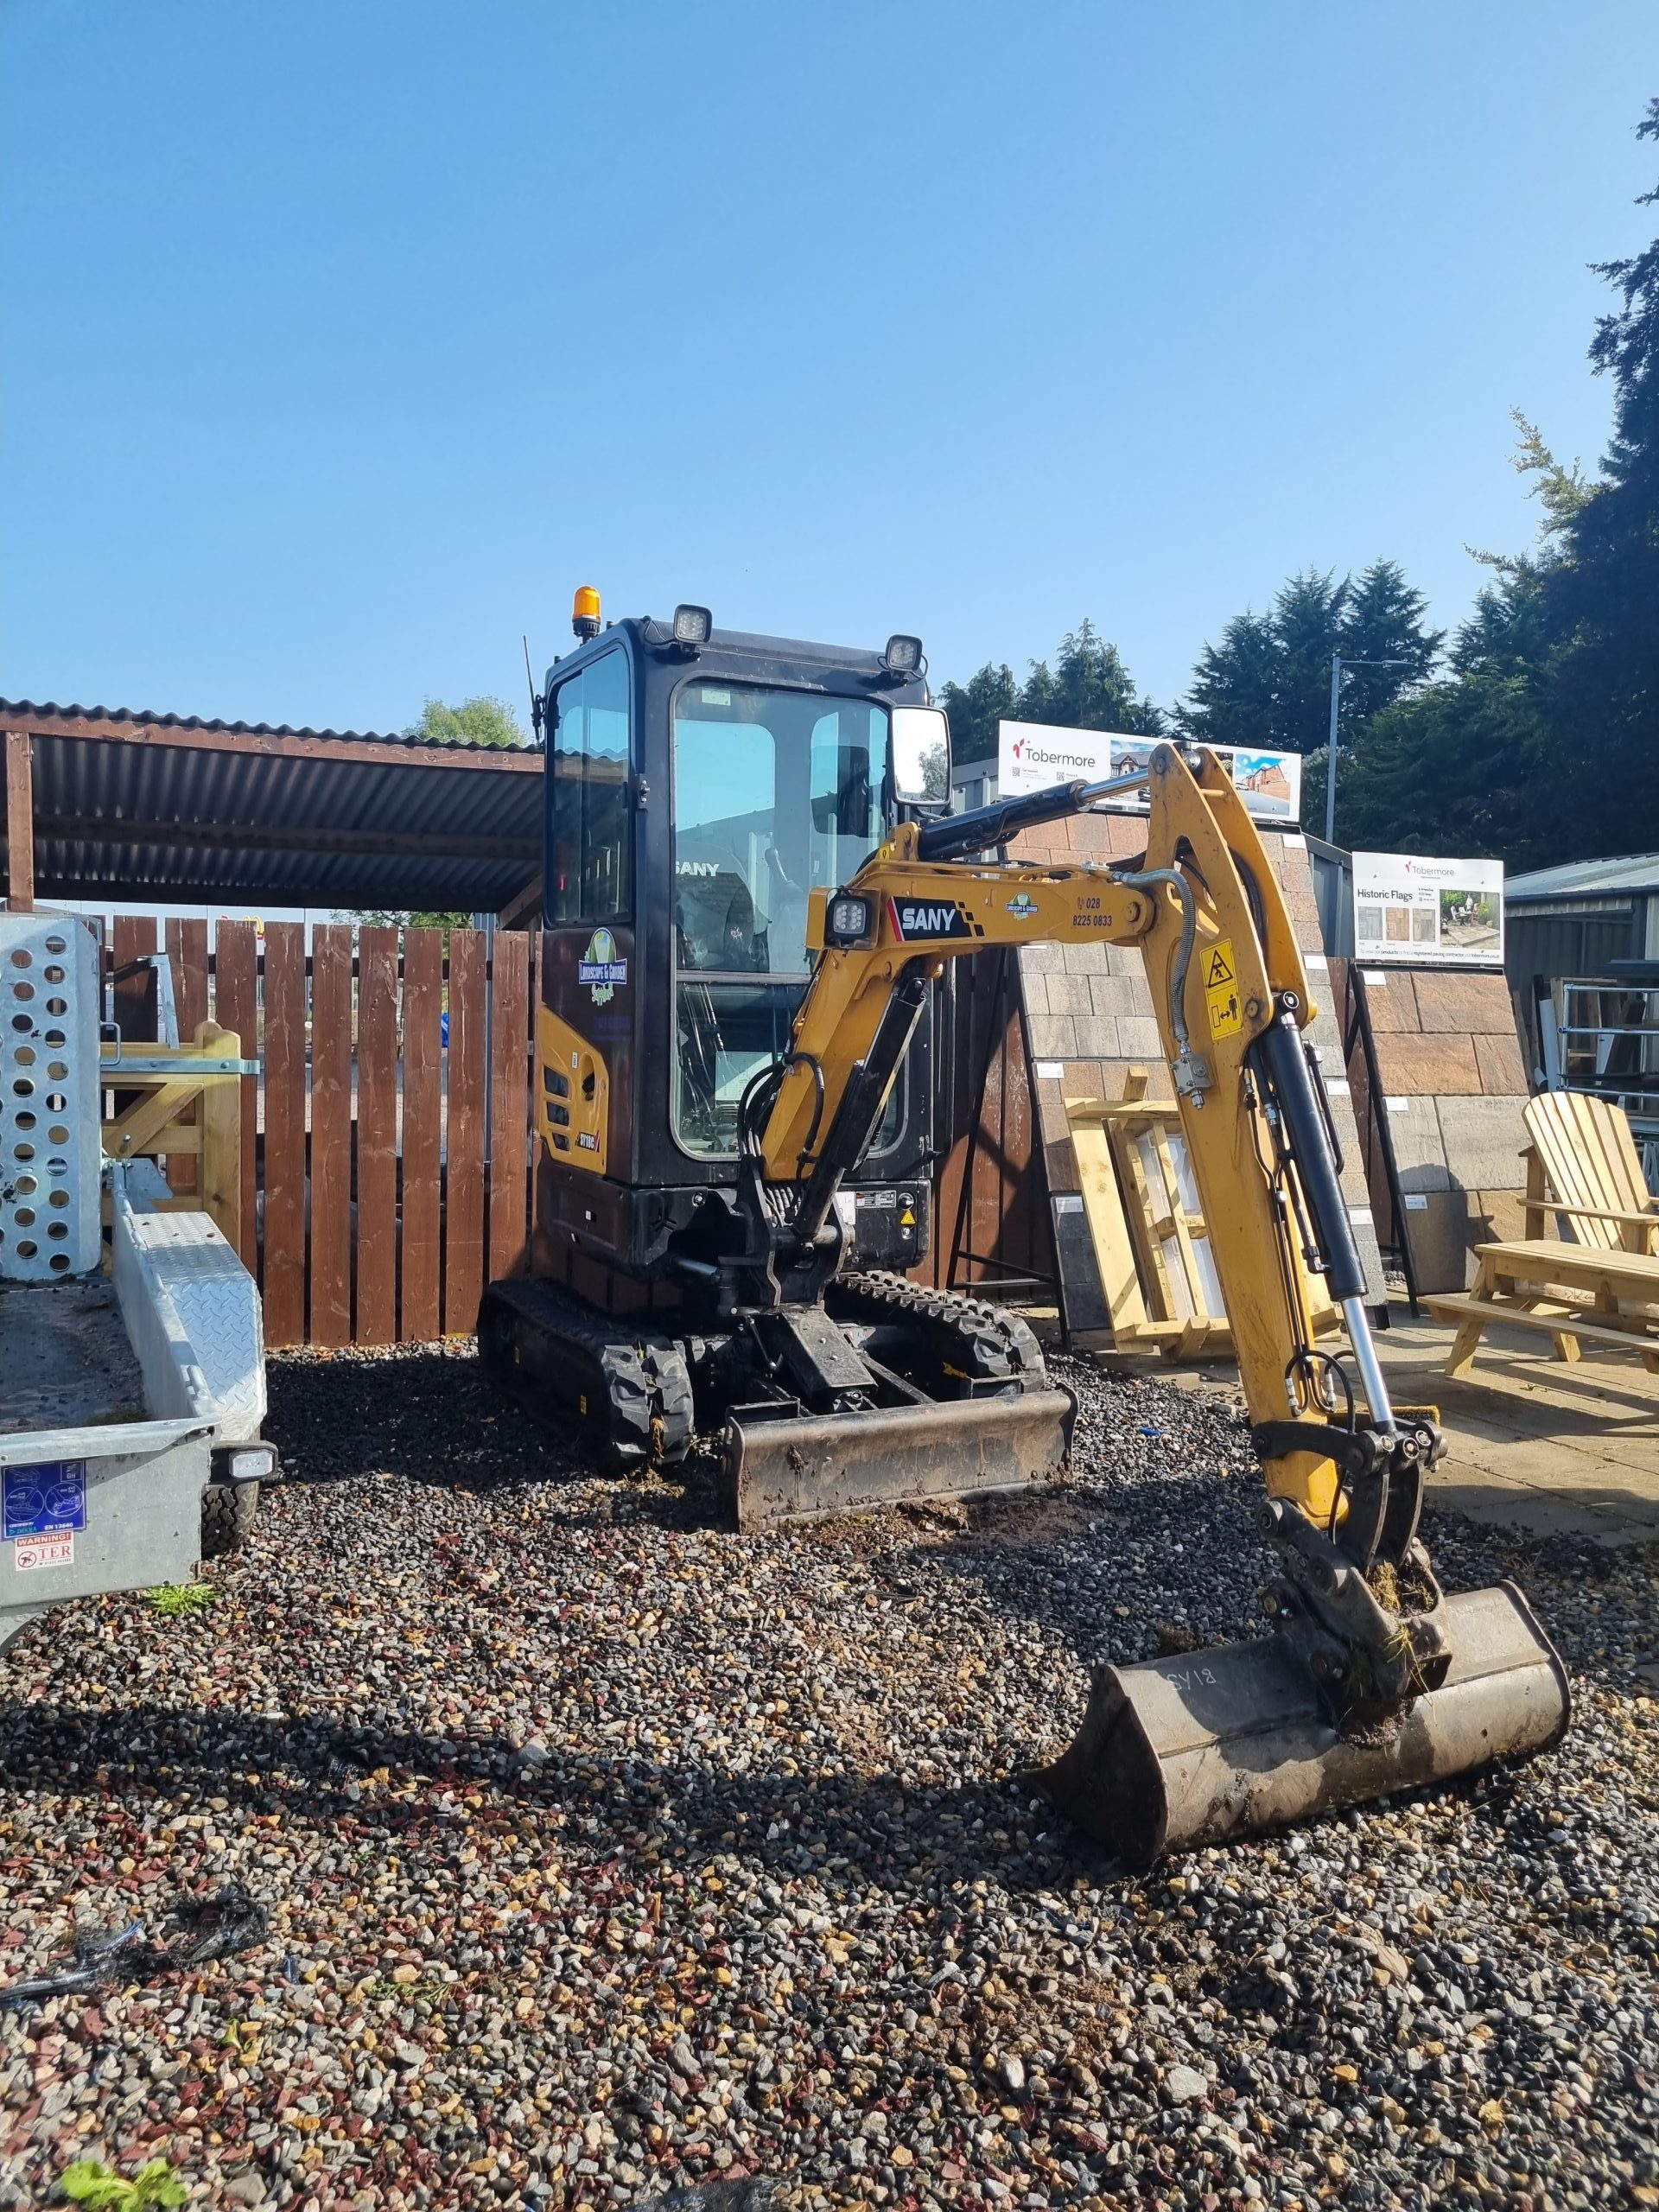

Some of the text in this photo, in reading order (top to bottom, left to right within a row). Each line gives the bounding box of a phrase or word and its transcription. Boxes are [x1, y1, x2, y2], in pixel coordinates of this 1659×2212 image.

[1025, 747, 1096, 768] Tobermore
[1413, 866, 1455, 876] Tobermore
[1357, 888, 1413, 902] Historic Flags
[1086, 898, 1101, 909] 028
[902, 907, 957, 931] SANY
[1072, 915, 1113, 927] 8225 0833
[17, 1533, 70, 1546] WARNING!
[38, 1545, 72, 1559] TER
[1167, 1667, 1217, 1691] SY18
